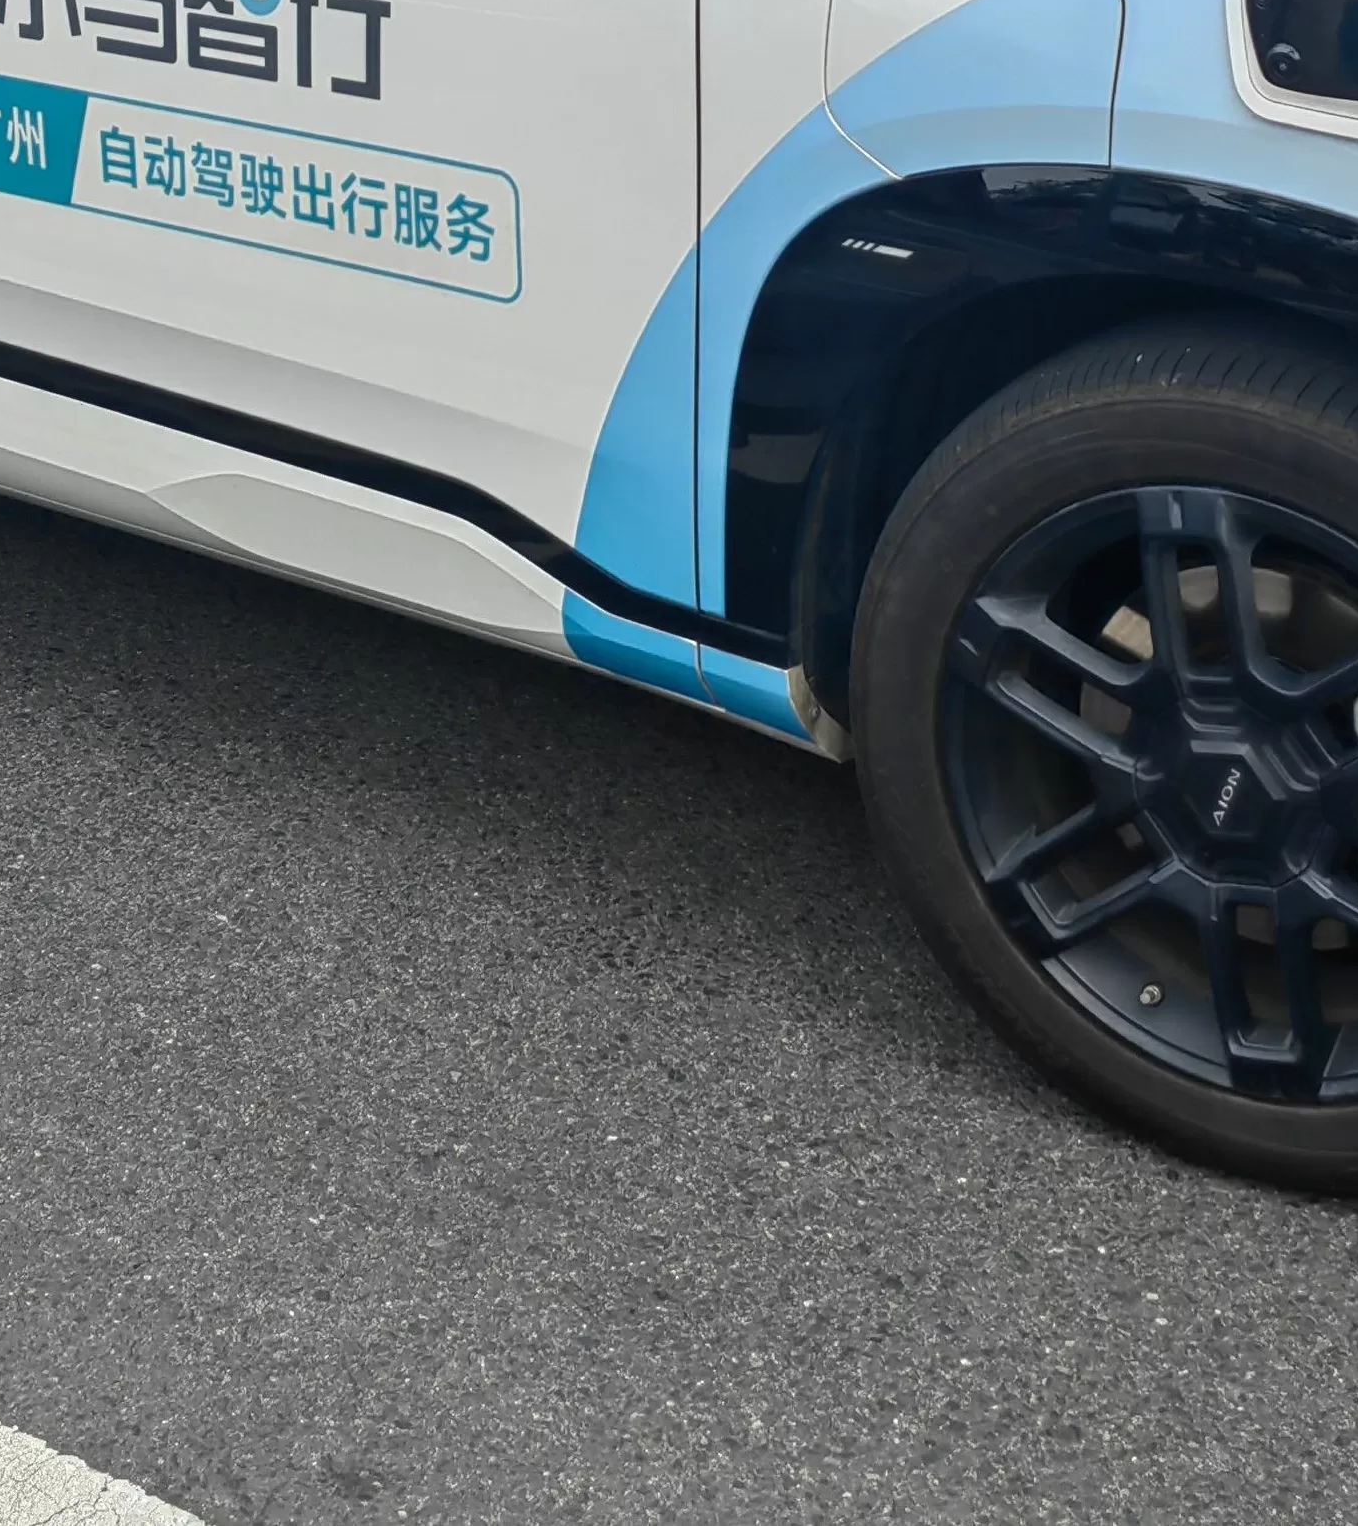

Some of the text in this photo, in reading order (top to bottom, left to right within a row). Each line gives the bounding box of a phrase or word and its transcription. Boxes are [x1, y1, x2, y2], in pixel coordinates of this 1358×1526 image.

[98, 126, 496, 263] 自动驾驶出行服务
[1212, 768, 1241, 828] AION
